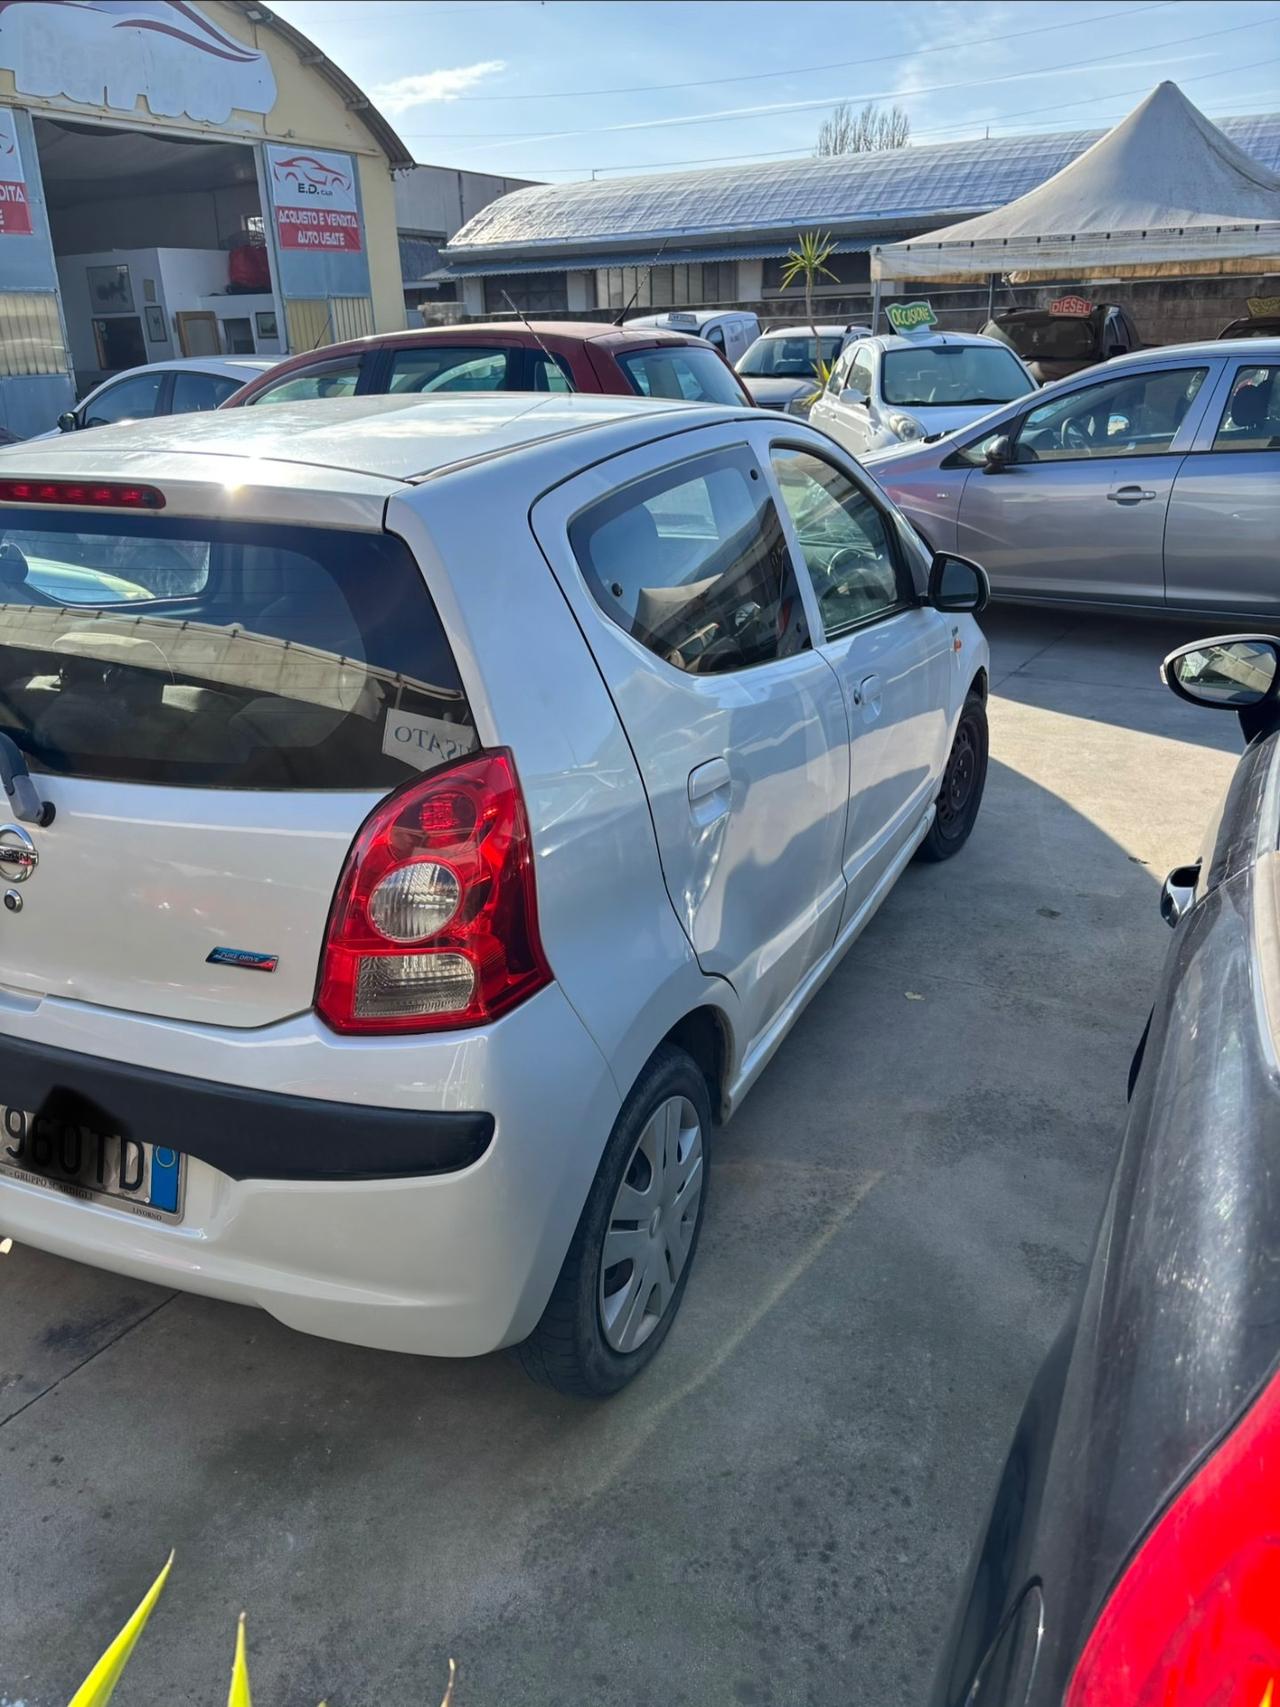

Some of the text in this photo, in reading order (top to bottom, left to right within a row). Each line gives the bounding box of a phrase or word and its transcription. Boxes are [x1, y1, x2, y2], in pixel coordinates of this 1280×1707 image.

[279, 210, 357, 228] ACQUISTO E VENDITA
[298, 231, 345, 245] AUTO USATE
[1052, 299, 1091, 314] DIESEL
[14, 1170, 47, 1187] GRUPPO
[132, 1207, 162, 1221] LIVORNO
